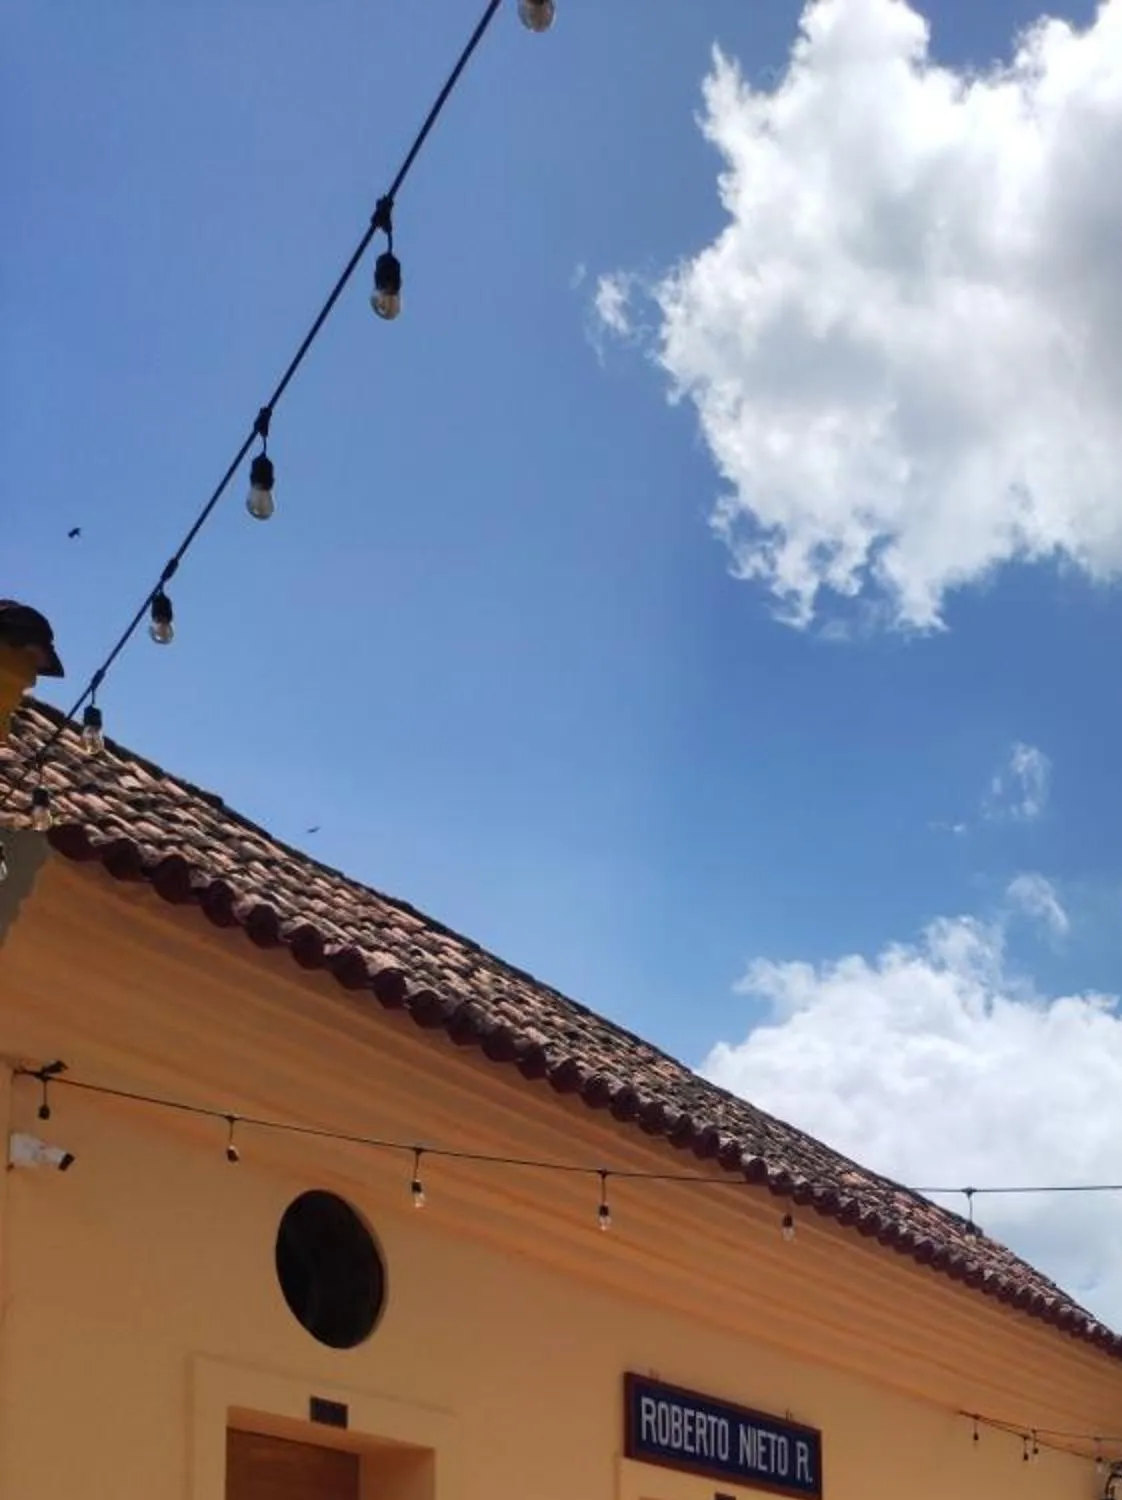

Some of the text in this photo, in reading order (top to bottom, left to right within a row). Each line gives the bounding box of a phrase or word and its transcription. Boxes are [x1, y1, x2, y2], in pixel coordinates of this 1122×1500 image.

[641, 1396, 813, 1483] ROBERTO NIETO R.
